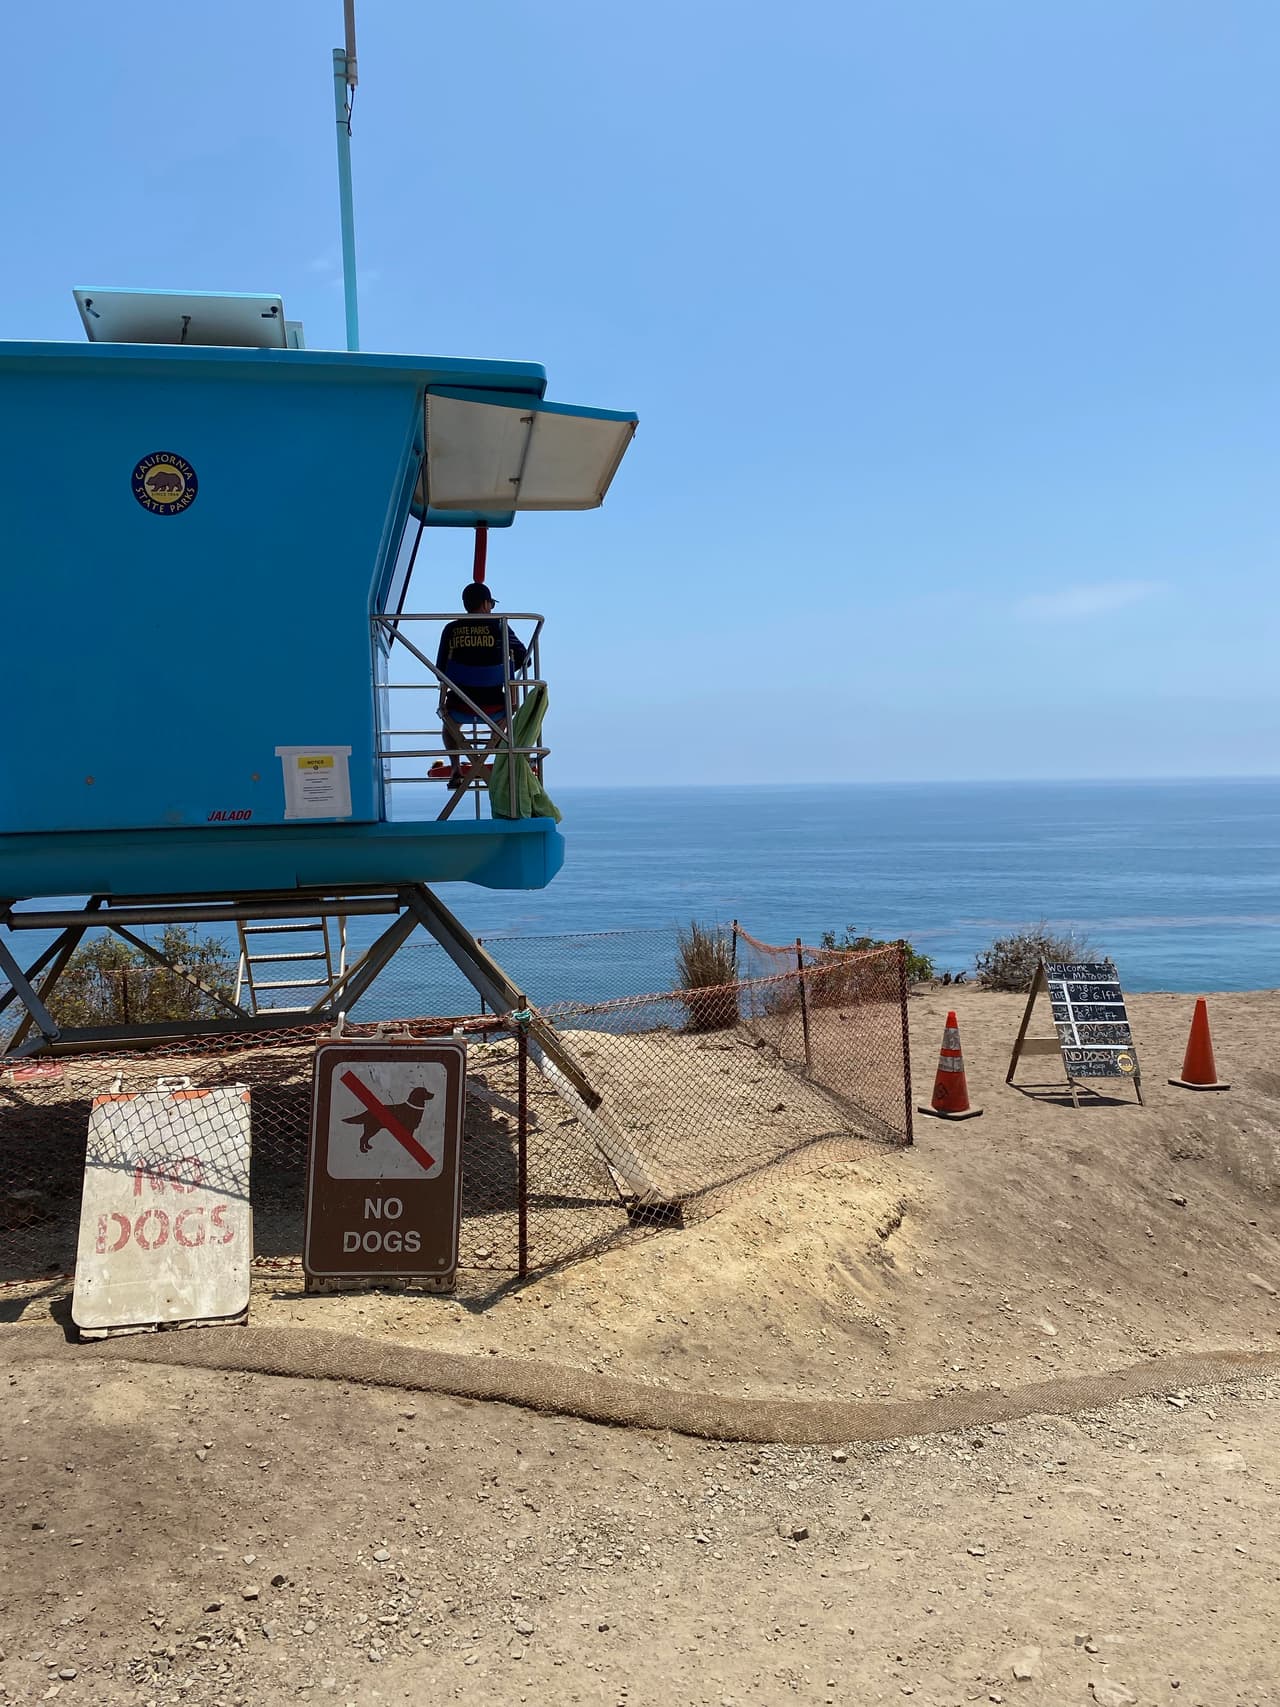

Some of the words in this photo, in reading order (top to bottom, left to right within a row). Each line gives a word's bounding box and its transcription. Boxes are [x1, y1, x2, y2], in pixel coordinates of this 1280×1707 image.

[135, 454, 193, 480] CALIFORNIA
[135, 487, 165, 513] STATE
[169, 487, 195, 513] PARKS
[453, 626, 470, 636] STATE
[470, 625, 490, 635] PARKS
[449, 635, 495, 649] LIFEGUARD
[207, 810, 252, 822] JALADO
[1047, 962, 1089, 973] Welcome
[1064, 1048, 1082, 1062] NO
[133, 1155, 204, 1198] NO
[364, 1197, 403, 1219] NO
[95, 1204, 236, 1255] DOGS
[343, 1230, 421, 1253] DOGS
